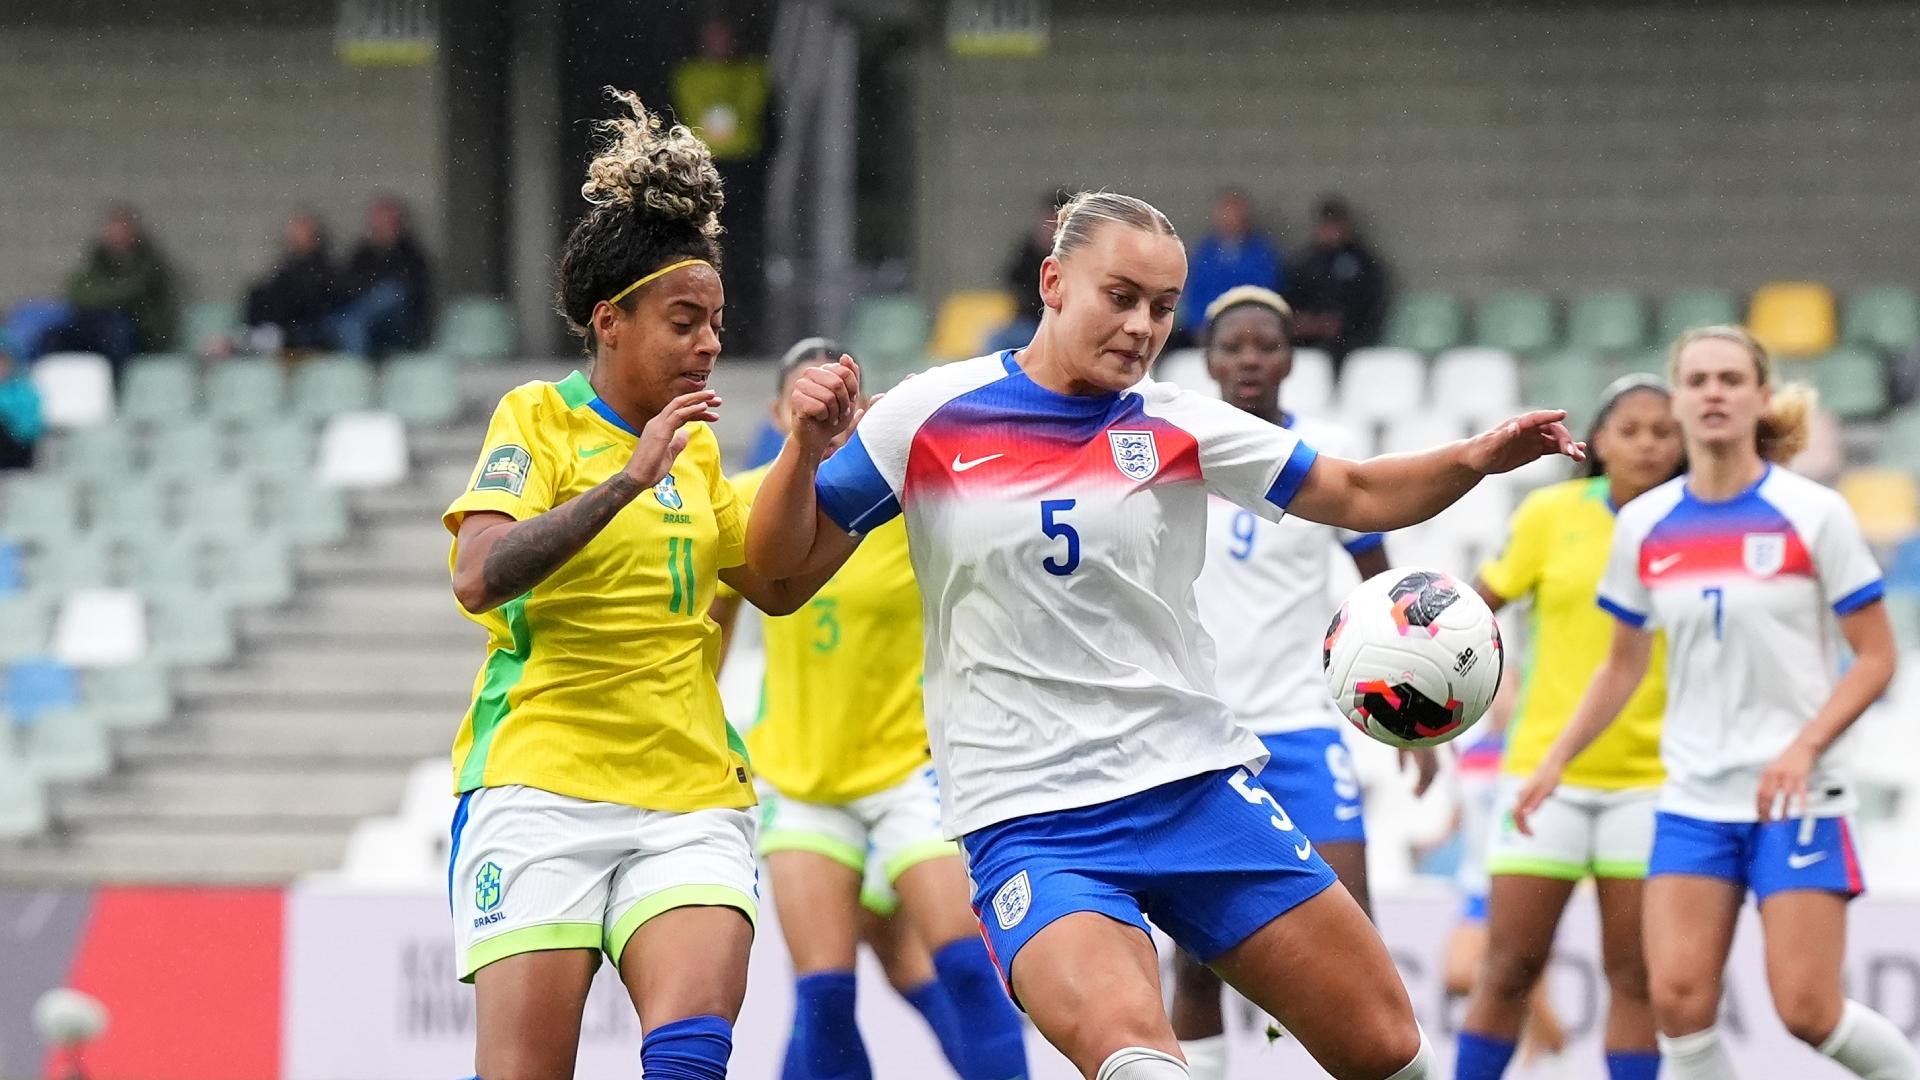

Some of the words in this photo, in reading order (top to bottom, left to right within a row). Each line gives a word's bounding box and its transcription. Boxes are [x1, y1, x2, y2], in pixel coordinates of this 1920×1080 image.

[663, 513, 692, 524] BRASIL
[1040, 499, 1080, 576] 5
[1230, 509, 1256, 560] 9
[668, 537, 694, 616] 11
[813, 597, 840, 653] 3
[1702, 587, 1722, 641] 7
[1227, 768, 1294, 832] 5
[474, 911, 506, 928] BRASIL
